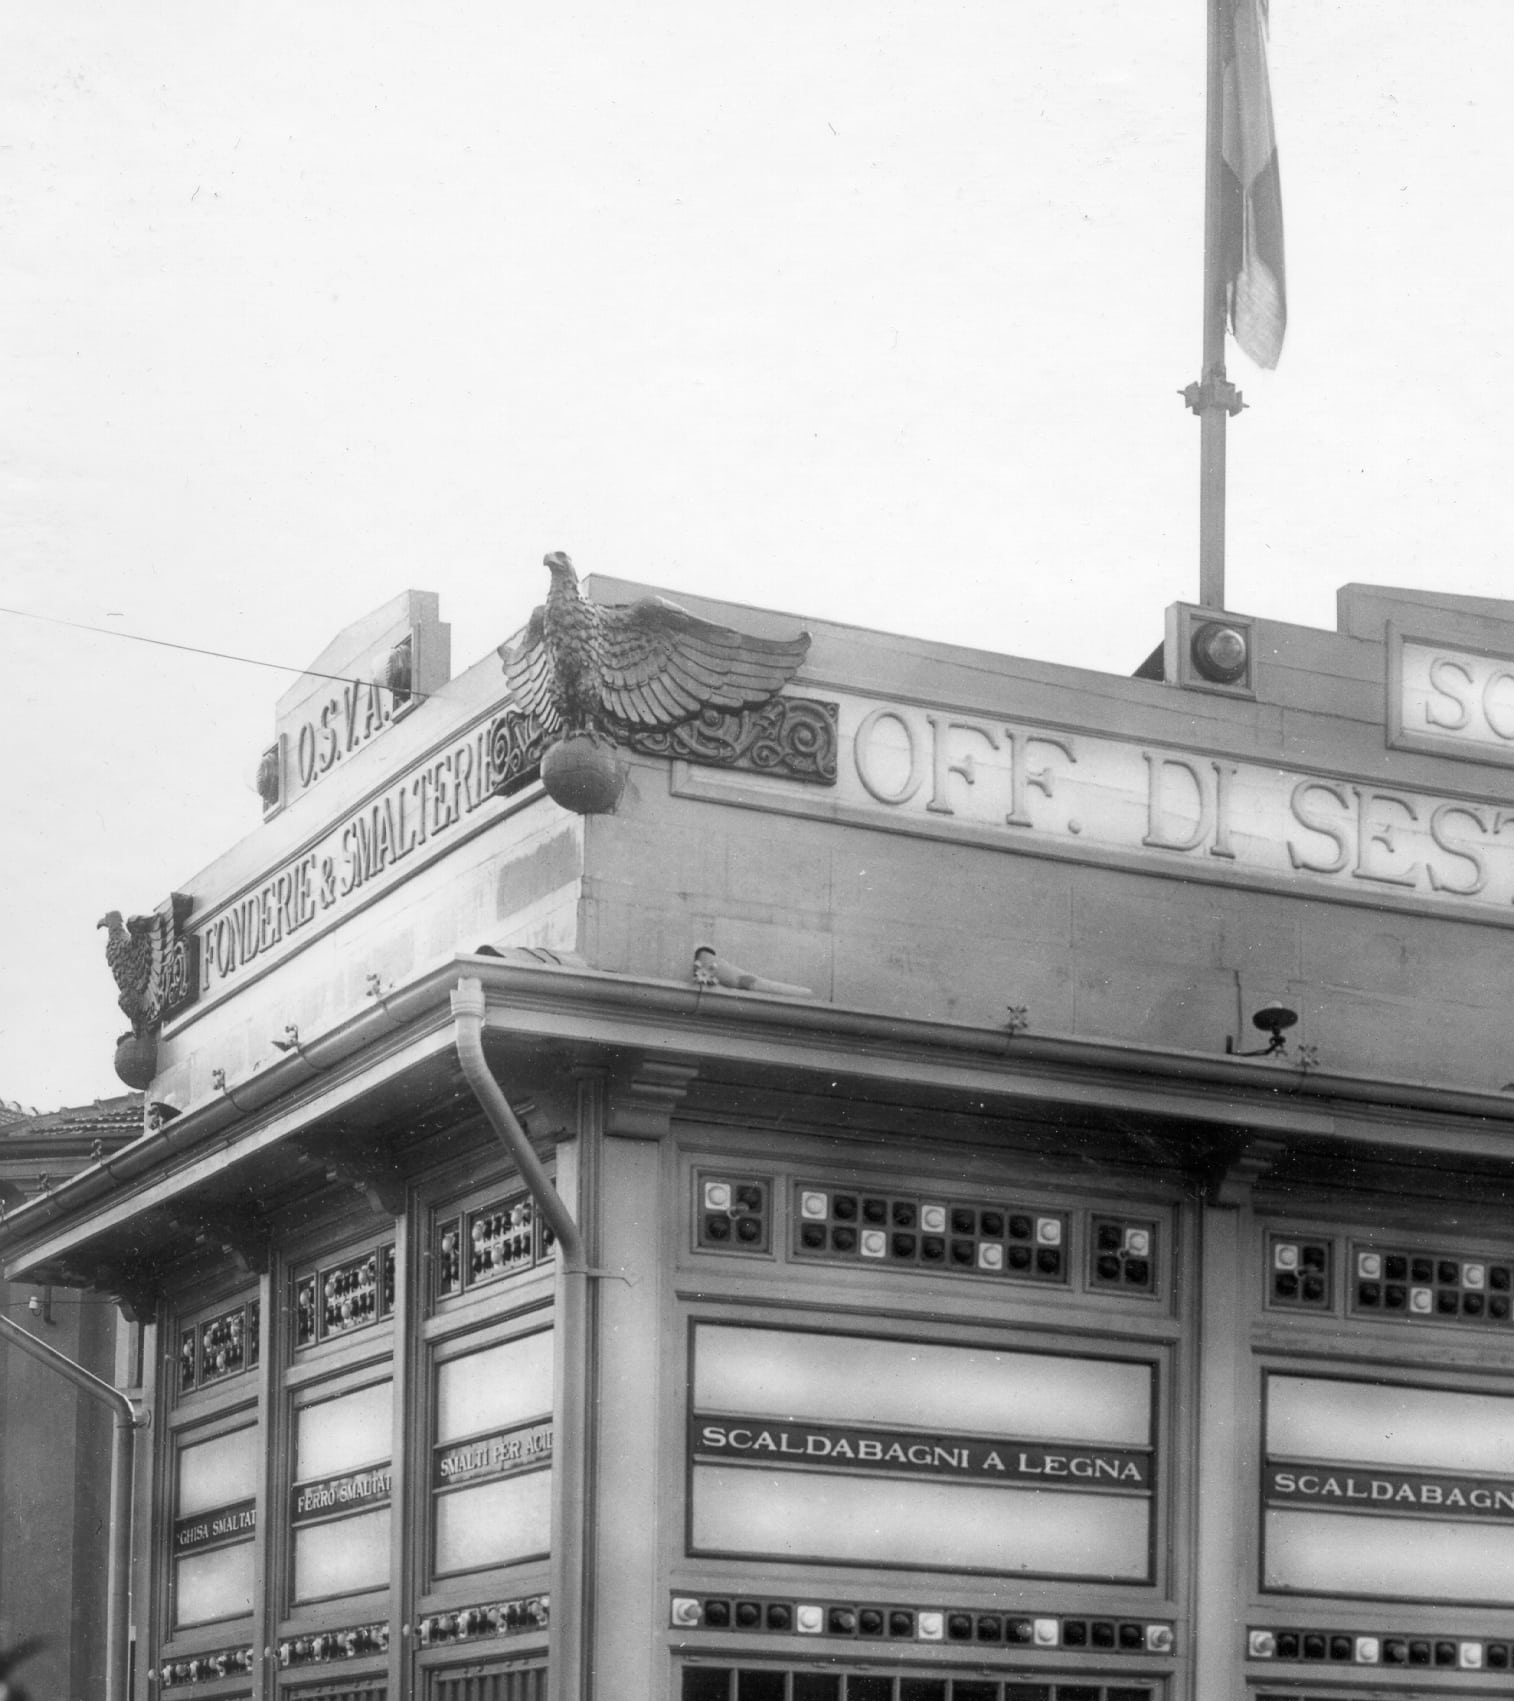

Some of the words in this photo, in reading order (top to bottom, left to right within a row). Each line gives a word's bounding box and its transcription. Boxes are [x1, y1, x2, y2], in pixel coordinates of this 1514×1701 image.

[853, 706, 1083, 836] OFF.
[1141, 750, 1238, 860] DI
[202, 853, 316, 992] FONDERIE
[320, 855, 336, 910] &
[440, 1447, 489, 1477] SMALTI
[493, 1439, 521, 1464] PER
[701, 1425, 970, 1469] SCALDABAGNI
[982, 1453, 1006, 1471] A
[1018, 1452, 1143, 1481] LEGNA
[297, 1489, 336, 1513] FERRO
[340, 1473, 393, 1503] SMALTAT
[179, 1523, 209, 1546] GHISA
[212, 1509, 257, 1536] SMALTAT
